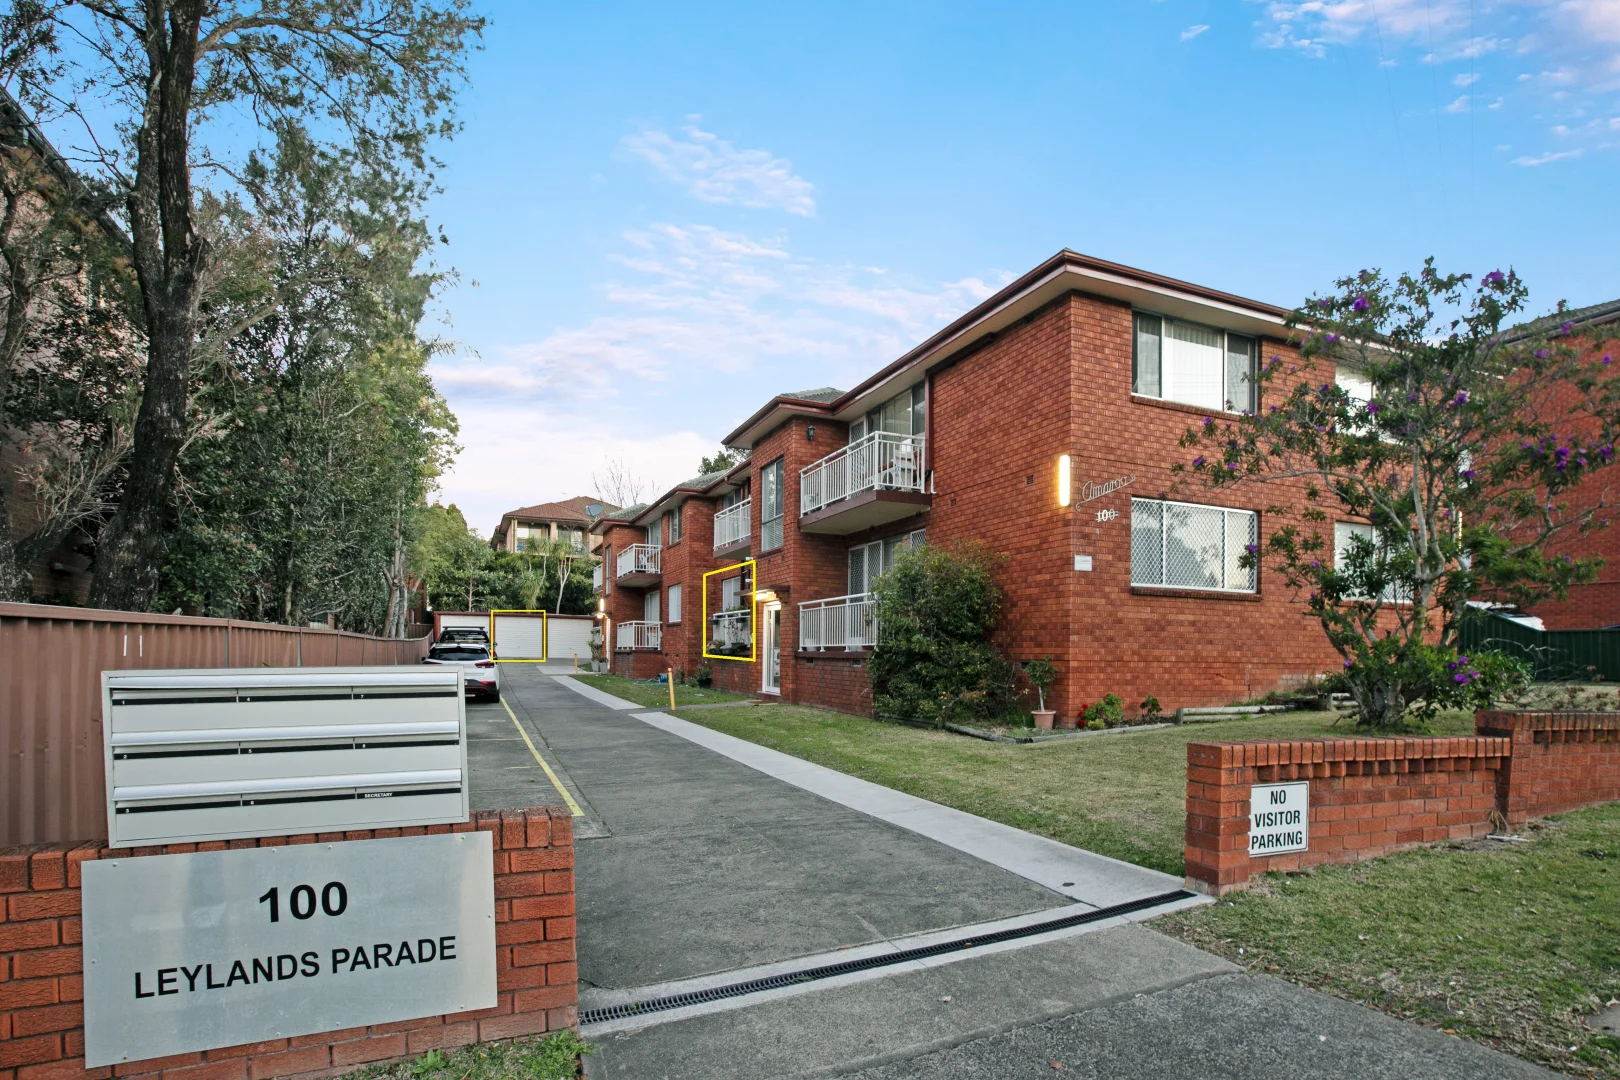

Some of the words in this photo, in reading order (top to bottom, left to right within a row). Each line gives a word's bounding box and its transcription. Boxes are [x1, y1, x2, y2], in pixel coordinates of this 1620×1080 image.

[1079, 475, 1129, 502] Amaroo
[1096, 508, 1116, 523] 100
[1270, 790, 1287, 805] NO
[1254, 810, 1301, 828] VISITOR
[1251, 831, 1303, 850] PARKING
[258, 881, 348, 923] 100
[134, 951, 320, 999] LEYLANDS
[331, 936, 457, 975] PARADE
